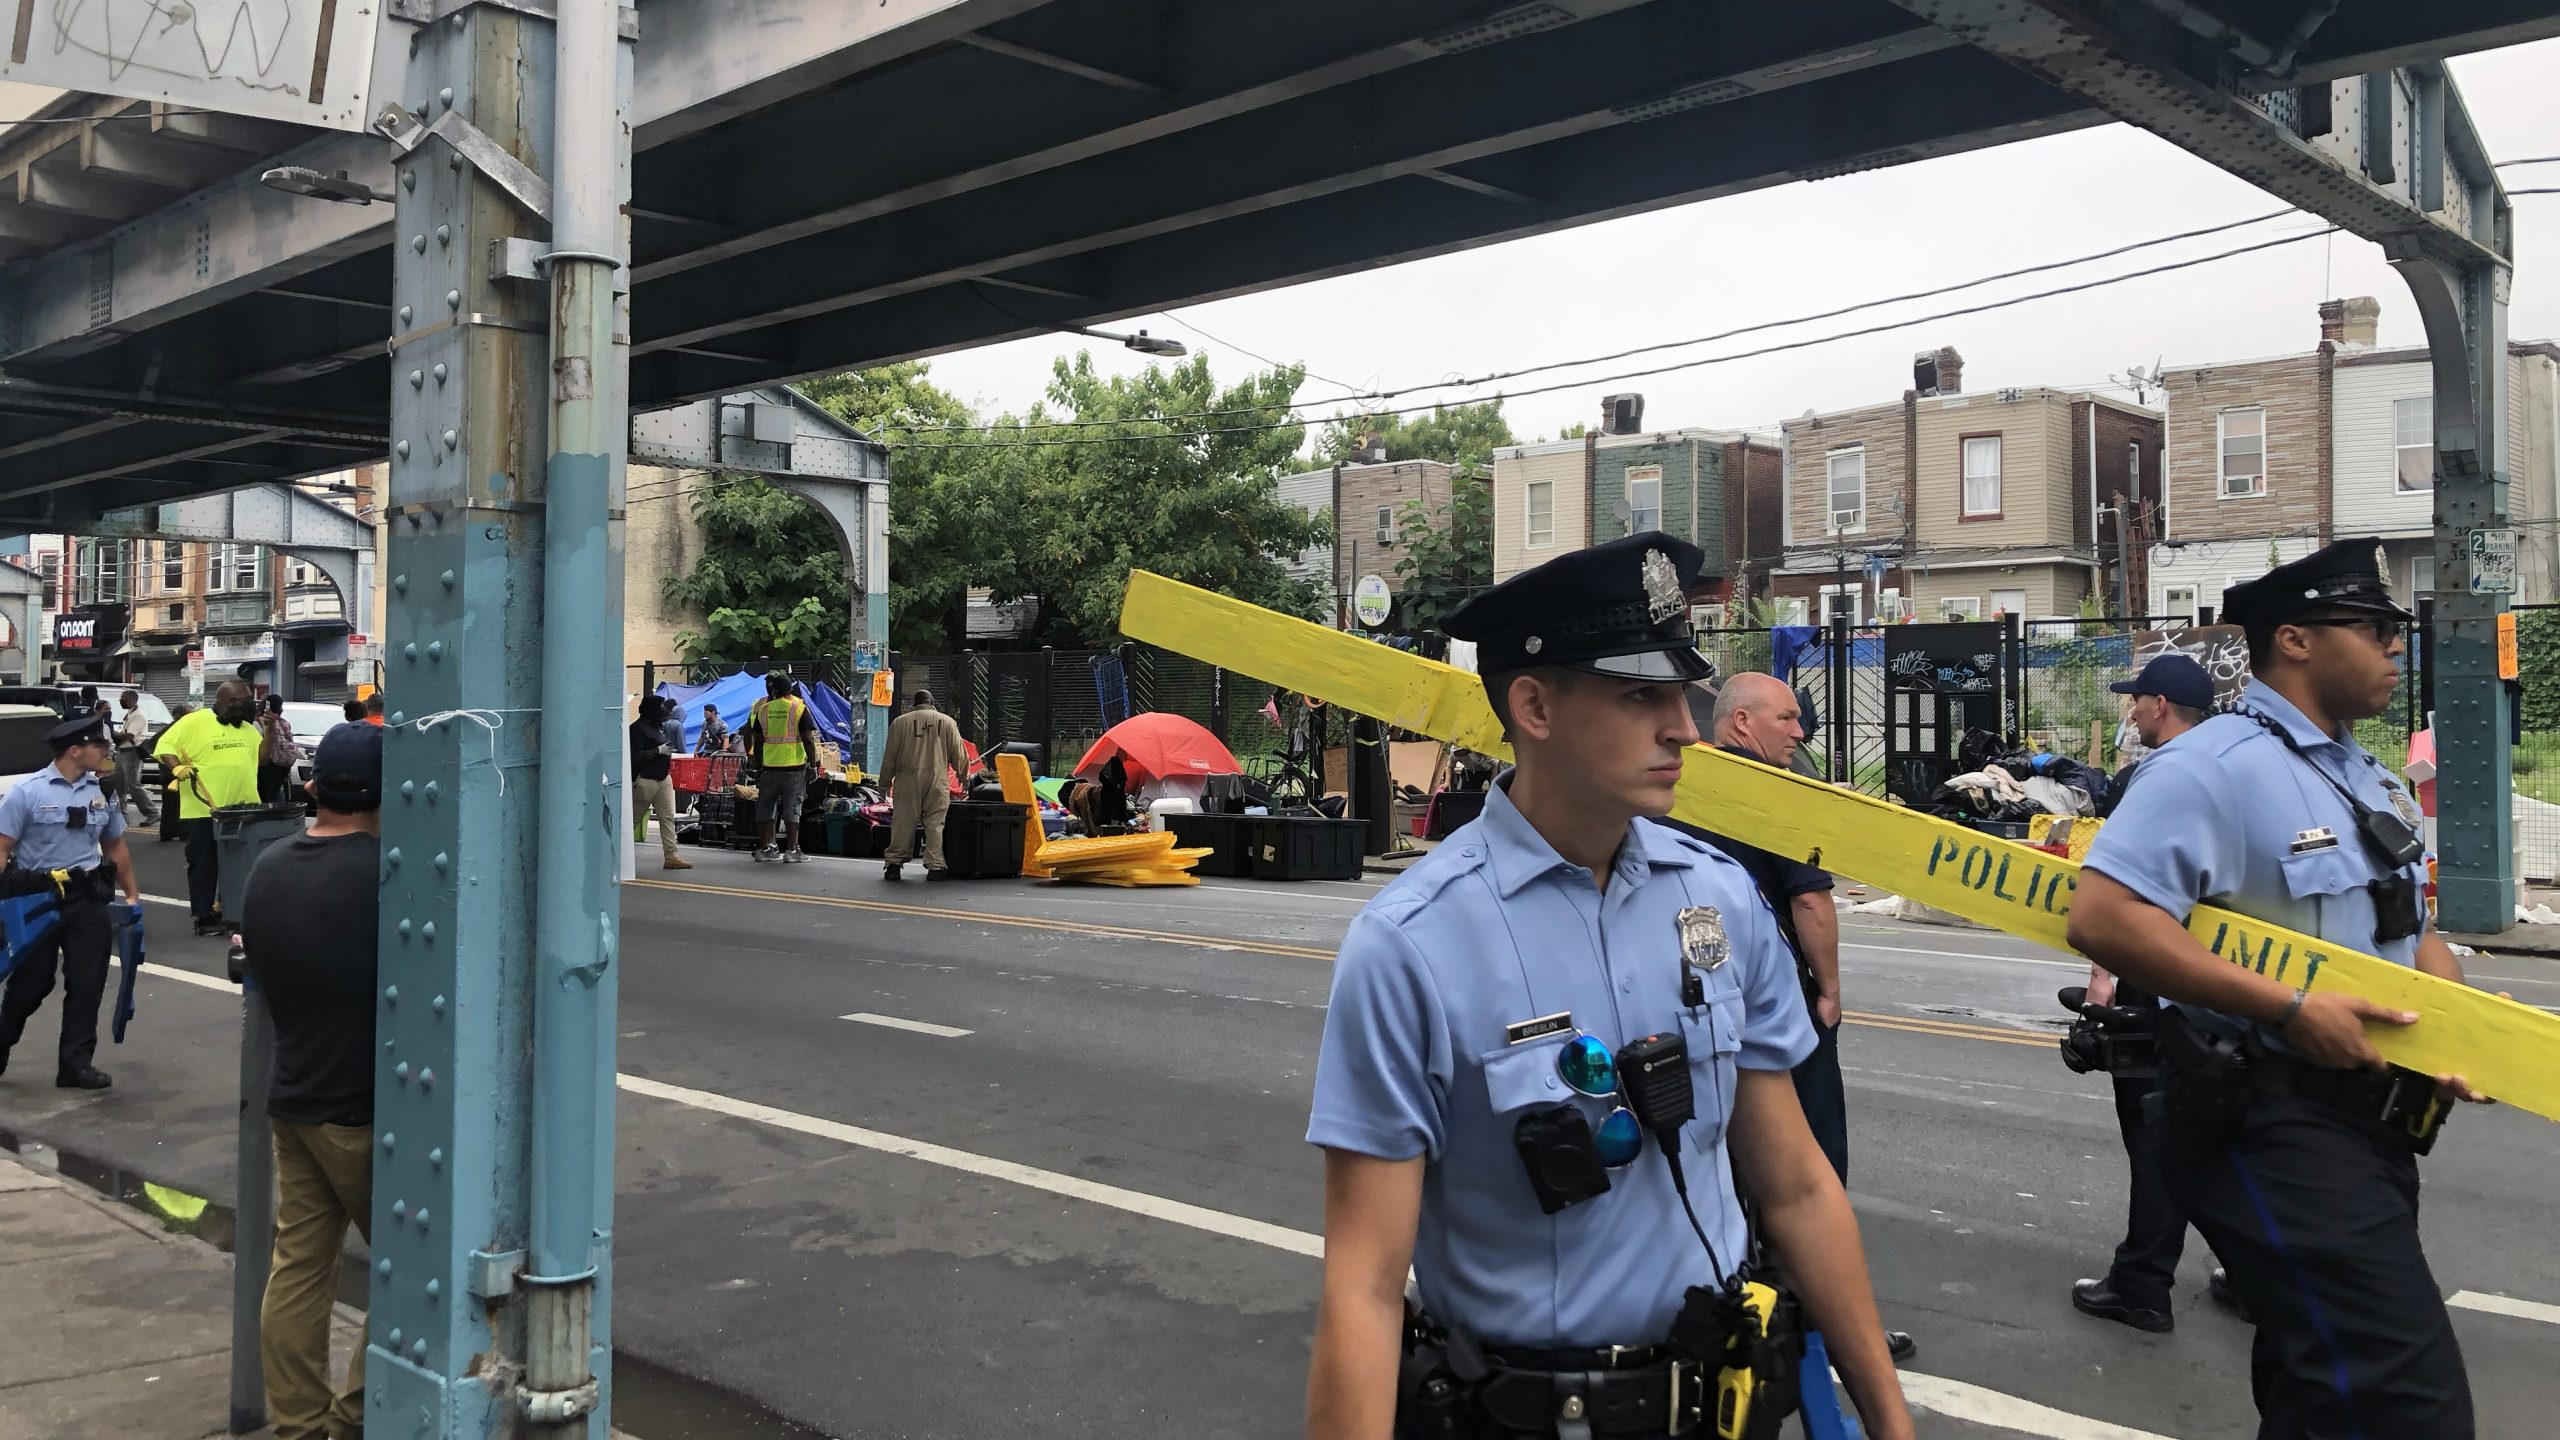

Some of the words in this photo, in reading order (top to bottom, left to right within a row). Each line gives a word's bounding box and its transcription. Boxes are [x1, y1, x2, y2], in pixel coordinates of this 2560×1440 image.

[2473, 534, 2483, 551] 2
[2495, 532, 2507, 541] HR
[2486, 542, 2515, 551] PARKING
[1928, 834, 2078, 917] POLIC
[1522, 1021, 1558, 1037] BRESLIN
